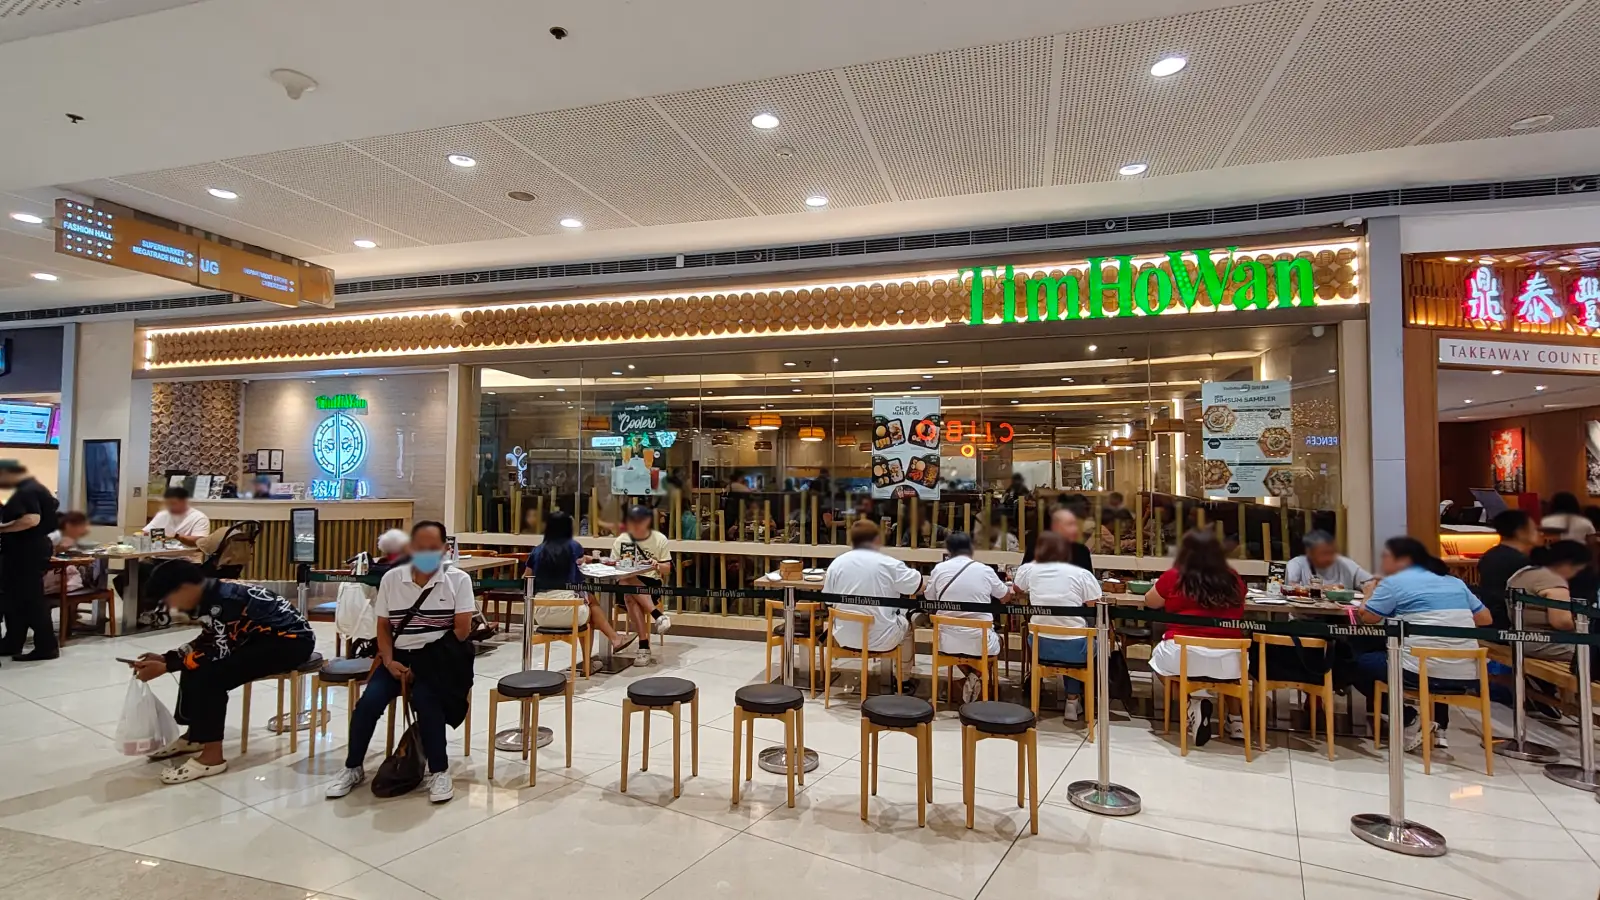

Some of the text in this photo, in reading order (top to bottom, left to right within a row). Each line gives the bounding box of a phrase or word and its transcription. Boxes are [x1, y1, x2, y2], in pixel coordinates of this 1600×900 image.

[63, 221, 113, 241] FASHION HALL
[141, 239, 185, 257] SUPERMARKET
[132, 246, 185, 266] MEGATRADE HALL
[200, 258, 219, 275] UG
[958, 246, 1317, 326] TimHoWan
[1450, 345, 1530, 362] TAKEAWAY
[619, 415, 656, 433] Coolers
[565, 583, 602, 591] TimHoWan
[635, 586, 673, 595] TimHoWan
[705, 589, 745, 598] TimHoWan
[840, 595, 880, 606] TimHoWan
[918, 600, 961, 610] TimHoWan
[1006, 605, 1052, 615] TimHoWan
[1327, 624, 1386, 636] TimHoWan
[1498, 630, 1550, 642] TimHoWan
